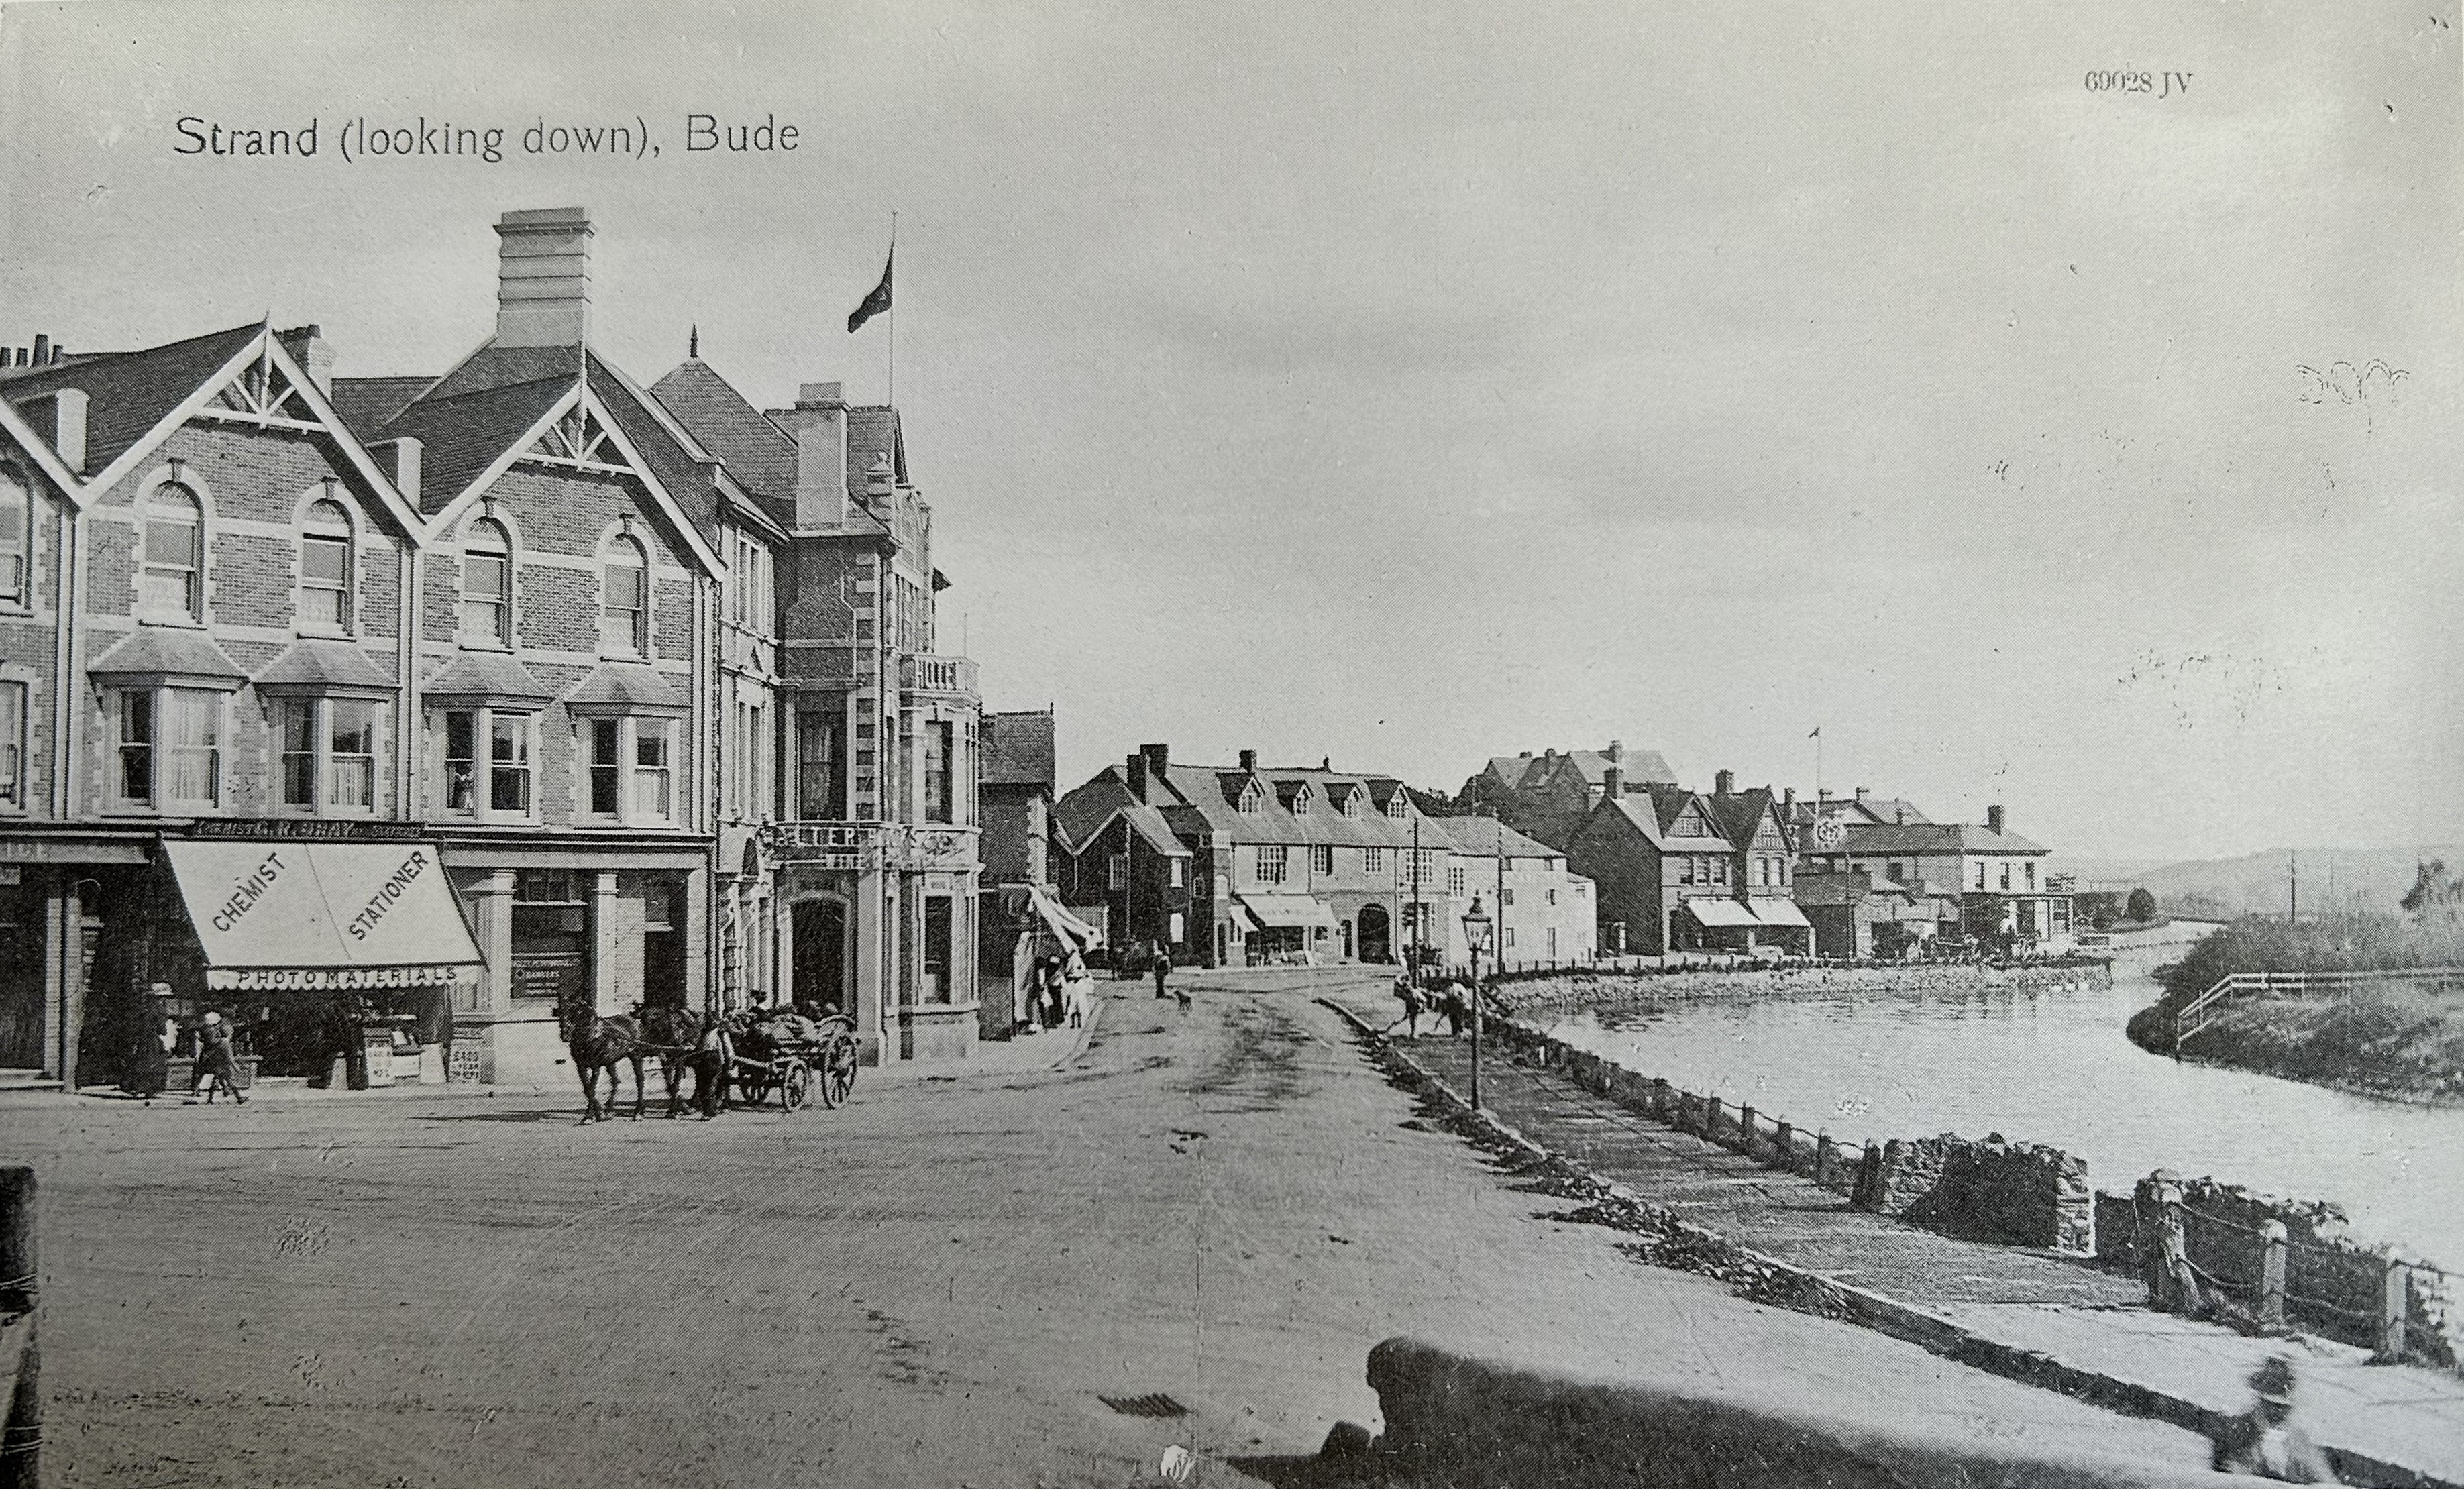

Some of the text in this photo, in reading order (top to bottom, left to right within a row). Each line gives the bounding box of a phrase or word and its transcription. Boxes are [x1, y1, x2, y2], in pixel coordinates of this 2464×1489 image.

[212, 851, 286, 932] CHEMIST
[347, 850, 429, 942] STATIONER
[237, 966, 457, 985] PHOTO MATERIALS
